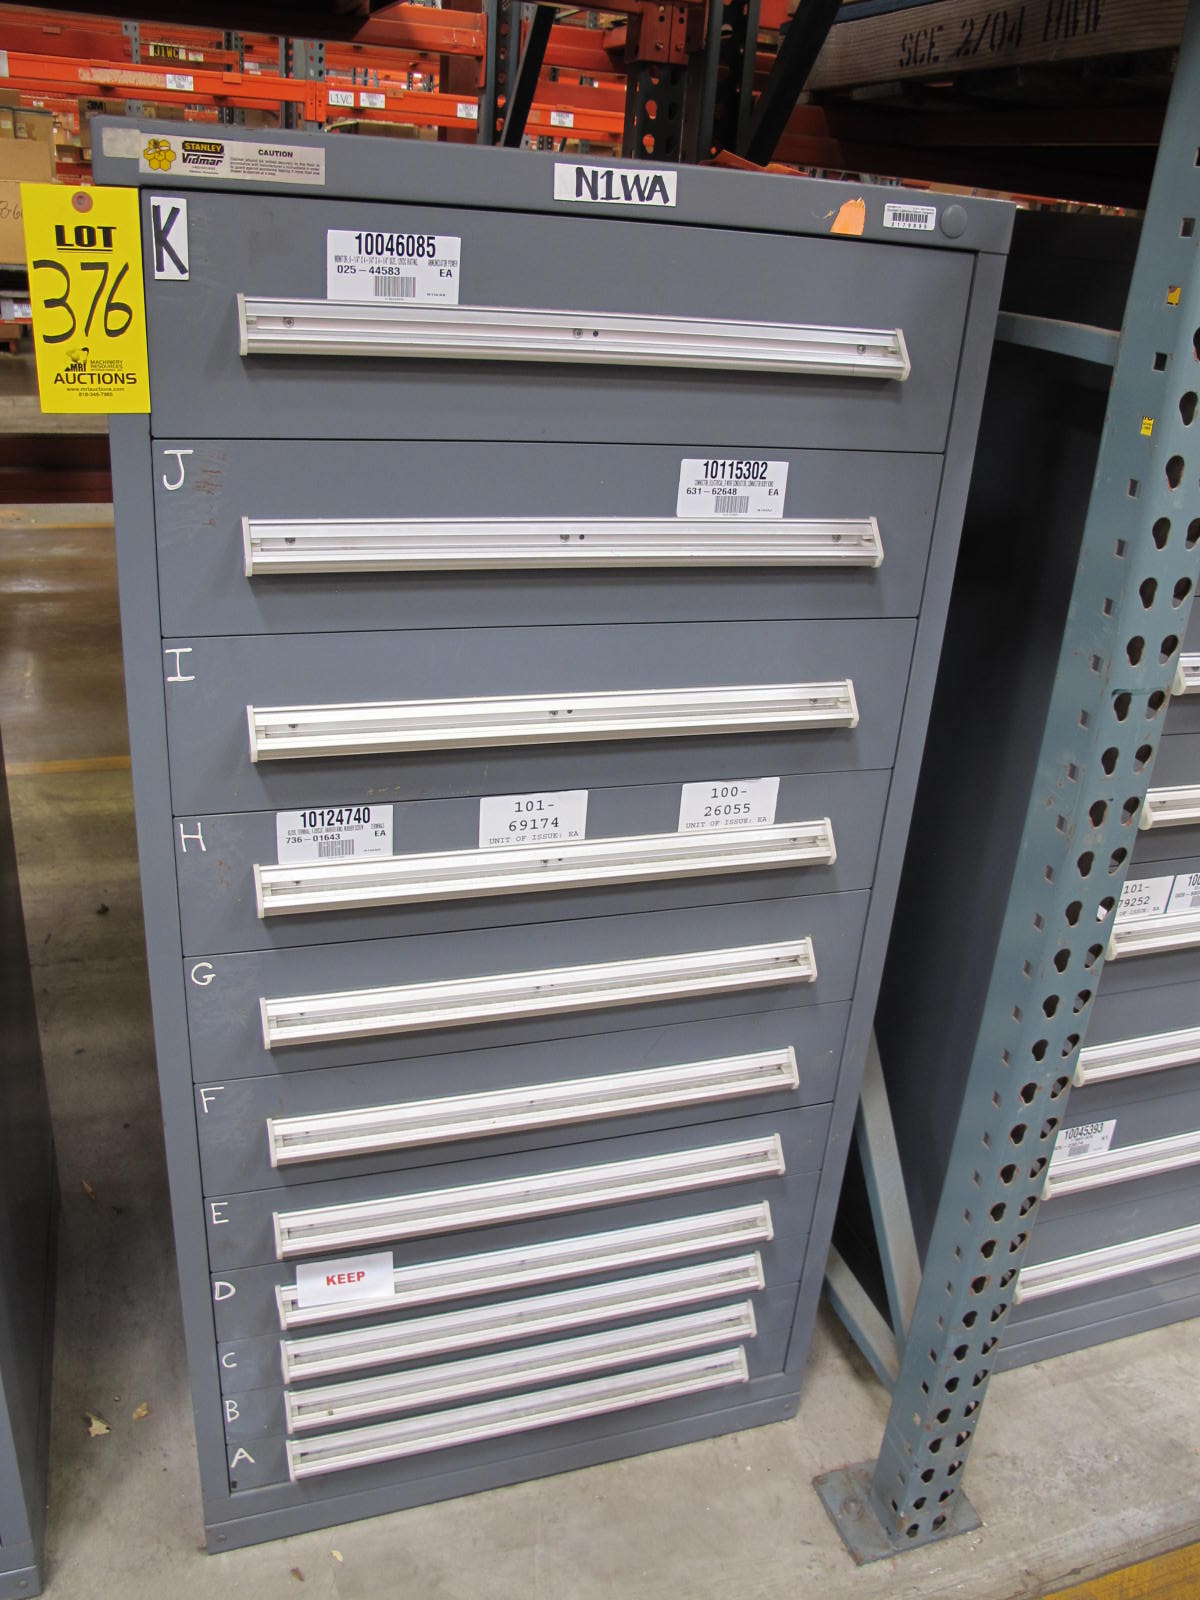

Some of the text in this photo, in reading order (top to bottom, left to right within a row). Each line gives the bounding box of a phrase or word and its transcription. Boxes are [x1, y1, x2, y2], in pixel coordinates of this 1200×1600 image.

[898, 25, 944, 67] SCE
[183, 141, 223, 153] STANLEY
[258, 149, 294, 158] CAUTION
[182, 153, 223, 166] Vidmar
[575, 166, 670, 205] N1WA
[54, 224, 118, 249] LOT
[152, 204, 189, 275] K
[355, 232, 437, 258] 10046085
[439, 268, 453, 278] EA
[32, 259, 133, 344] 376
[71, 362, 87, 372] MRI
[53, 372, 138, 385] AUCTIONS
[162, 449, 194, 491] J
[703, 460, 768, 480] 10115302
[767, 488, 780, 497] EA
[165, 647, 196, 682] I
[711, 786, 749, 799] 100-
[514, 799, 555, 813] 101-
[703, 802, 751, 817] 26055
[299, 806, 371, 829] 10124740
[508, 816, 560, 832] 69174
[685, 821, 706, 829] UNIT
[724, 818, 752, 826] ISSUE:
[757, 816, 768, 824] EA
[179, 822, 207, 853] H
[373, 829, 387, 838] EA
[489, 837, 511, 845] UNIT
[532, 832, 563, 841] ISSUE:
[1122, 883, 1151, 895] 101-
[191, 962, 216, 986] G
[200, 1086, 225, 1114] F
[210, 1202, 229, 1225] E
[326, 1270, 366, 1287] KEEP
[214, 1281, 236, 1301] D
[222, 1352, 237, 1368] C
[225, 1400, 240, 1423] B
[230, 1447, 256, 1469] A
